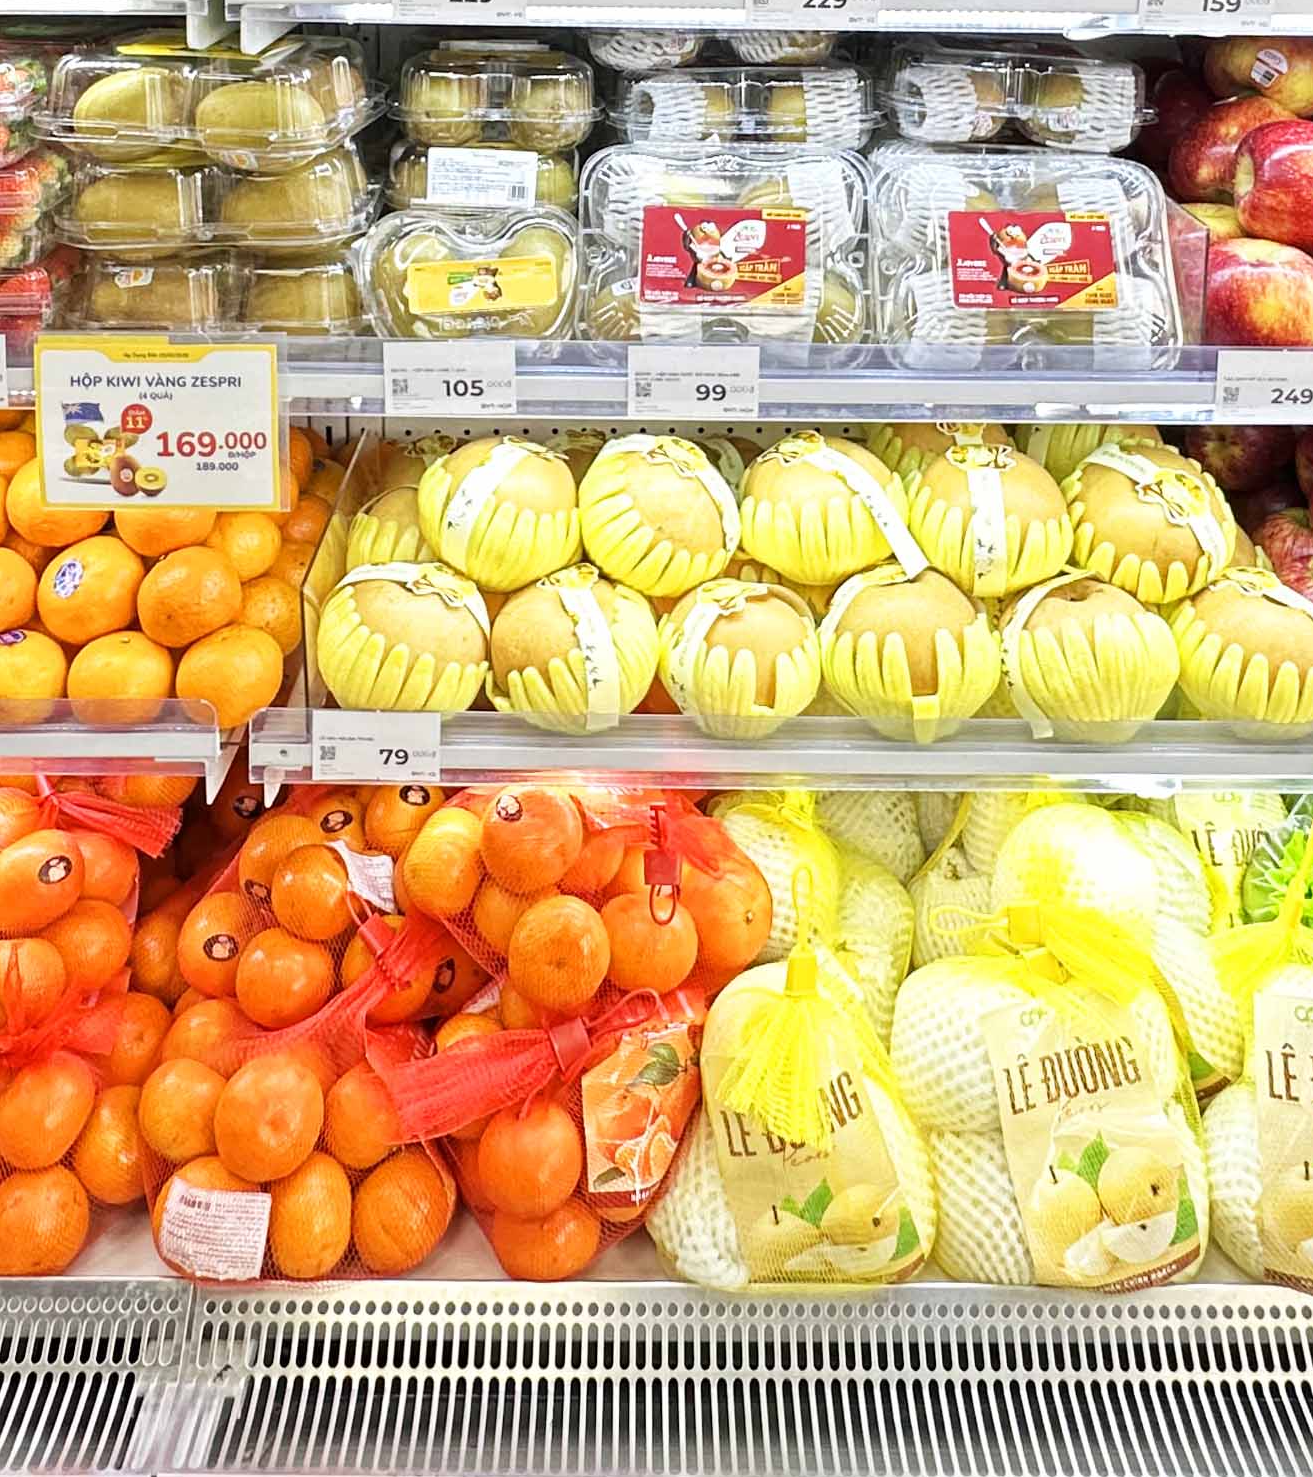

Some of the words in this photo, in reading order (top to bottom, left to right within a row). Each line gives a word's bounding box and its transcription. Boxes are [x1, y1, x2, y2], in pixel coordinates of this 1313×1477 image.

[71, 373, 102, 390] HỘP
[107, 376, 141, 388] KIWI
[145, 373, 187, 388] VÀNG
[191, 376, 242, 388] ZESPRI
[442, 379, 484, 397] 105
[696, 385, 727, 401] 99
[1271, 389, 1313, 404] 249
[156, 431, 267, 457] 169.000
[196, 462, 239, 472] 189.000
[380, 749, 409, 765] 79
[1266, 1042, 1301, 1103] LÊ
[1003, 1053, 1037, 1115] LÊ
